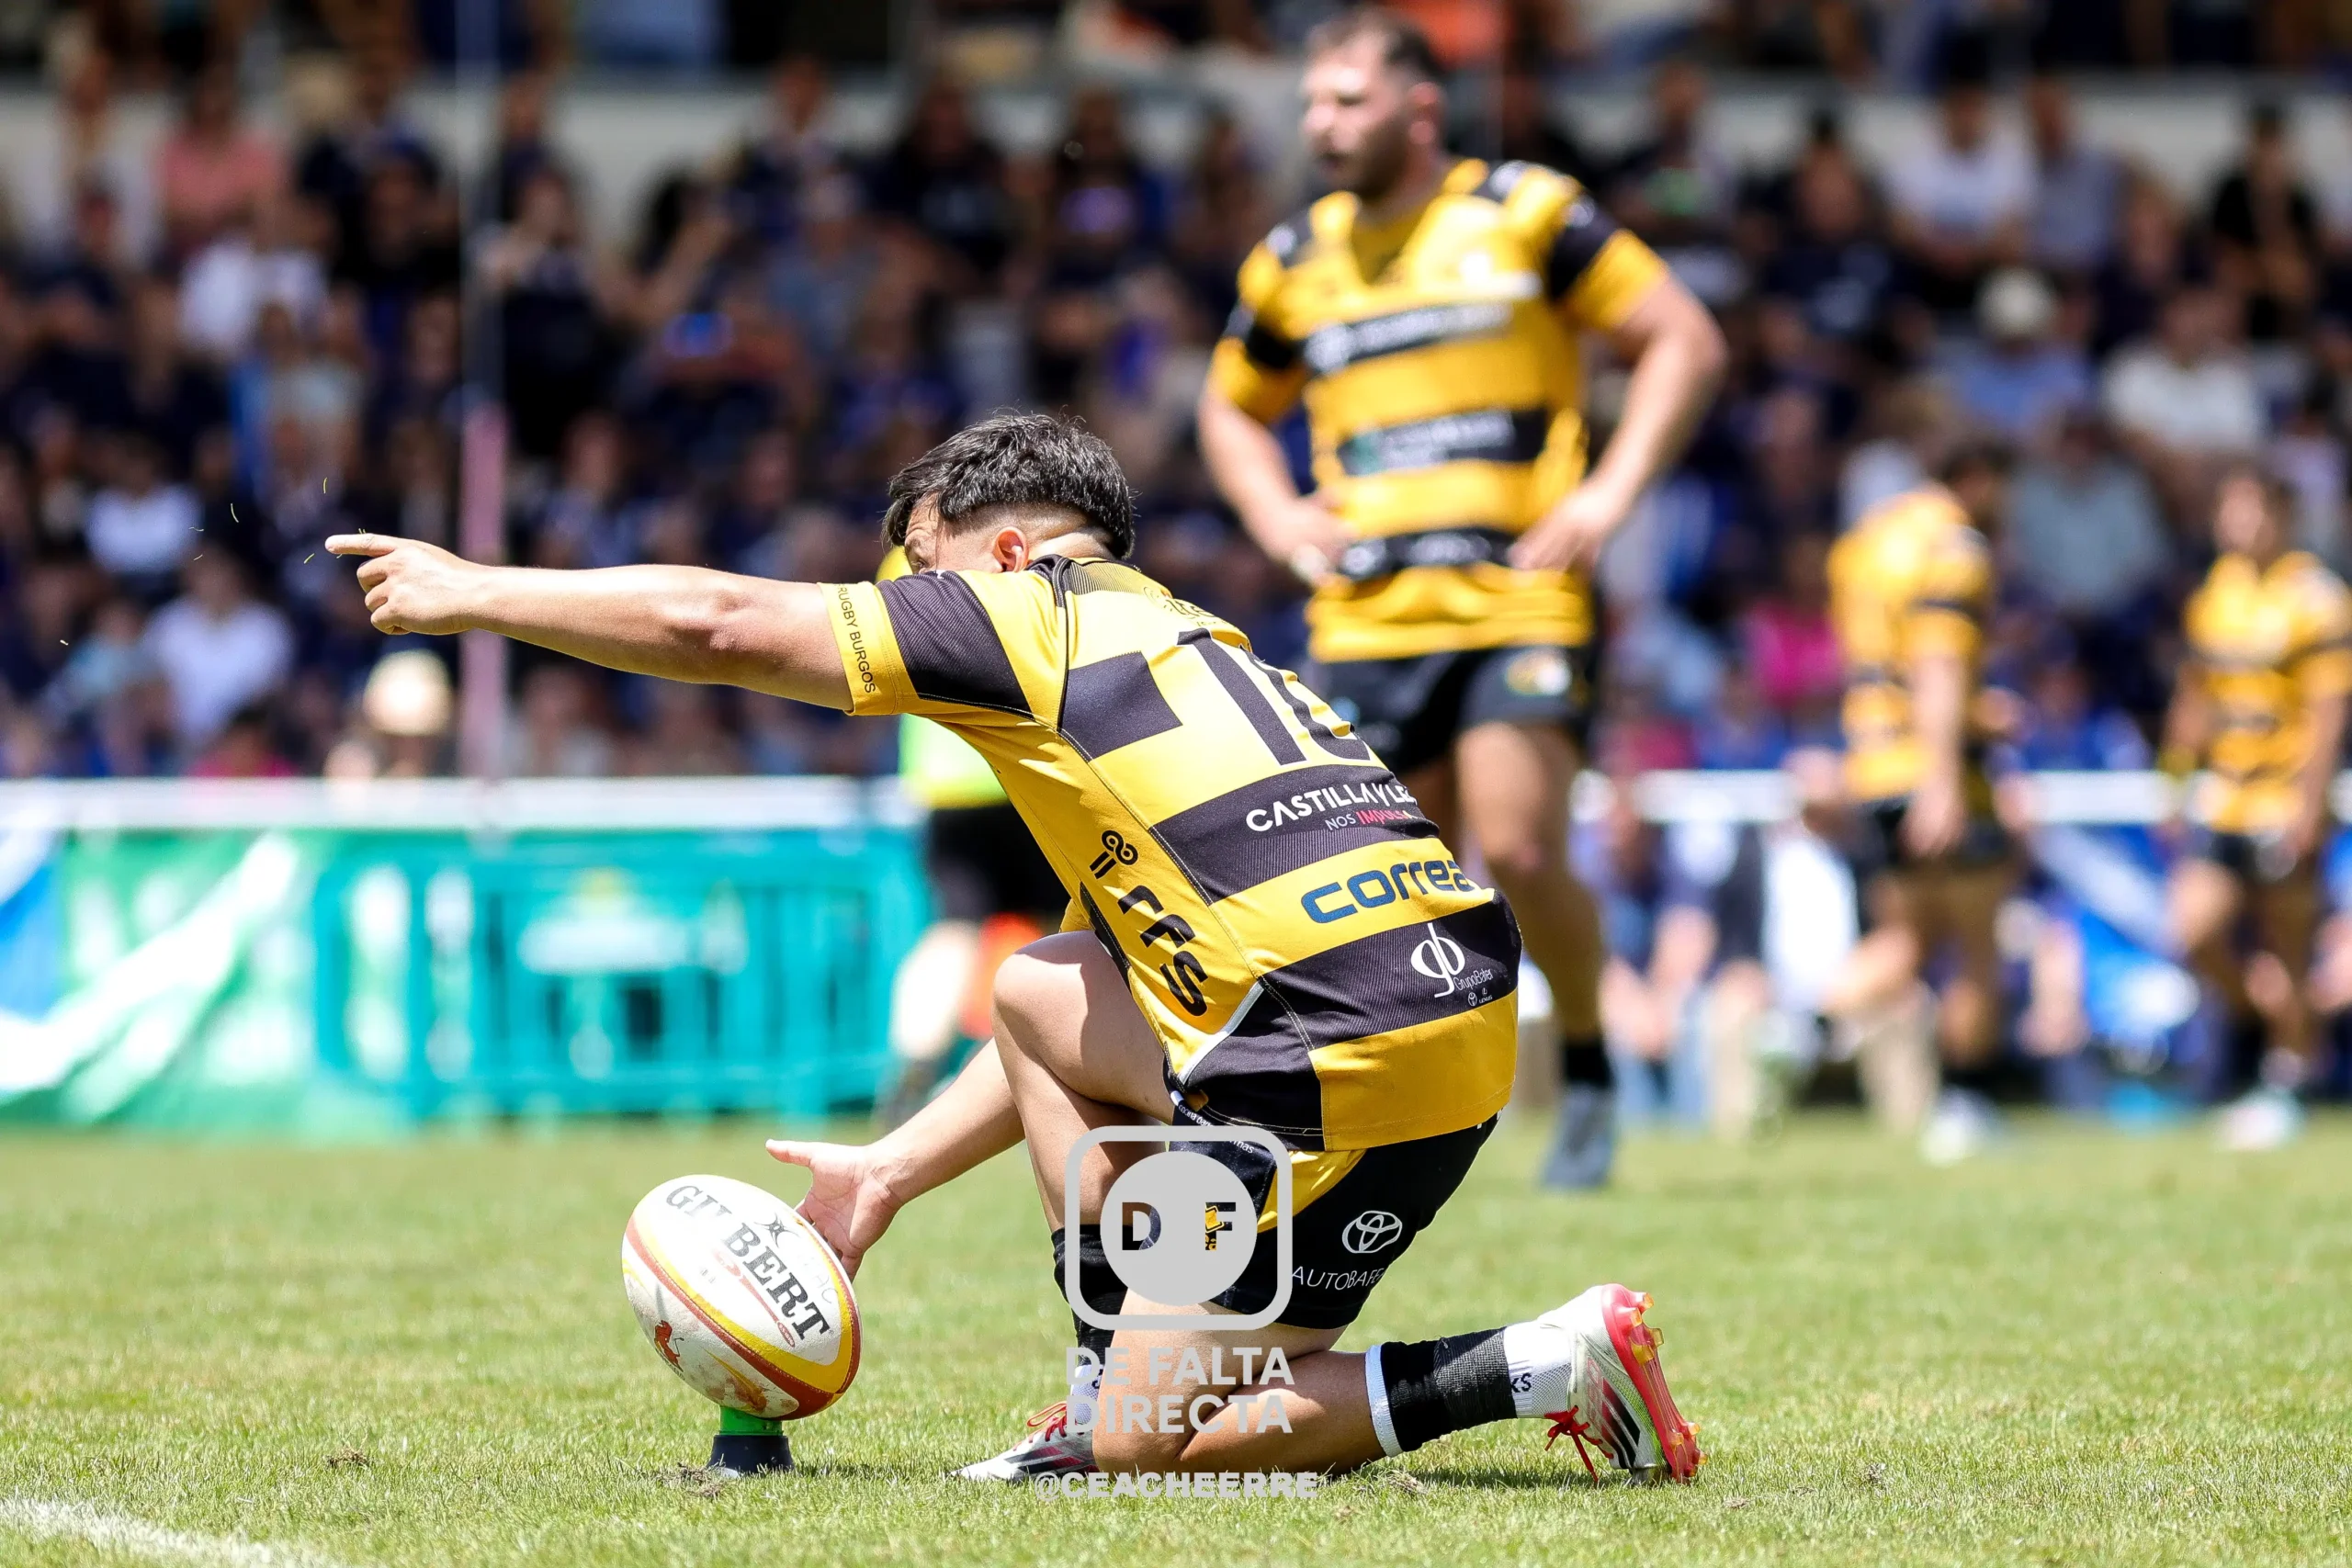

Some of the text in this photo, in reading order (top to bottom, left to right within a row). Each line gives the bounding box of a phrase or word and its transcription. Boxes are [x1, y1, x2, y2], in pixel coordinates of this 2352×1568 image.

[837, 586, 876, 694] RUGBY BURGOS
[1245, 782, 1374, 832] CASTILLA
[1324, 812, 1357, 832] NOS
